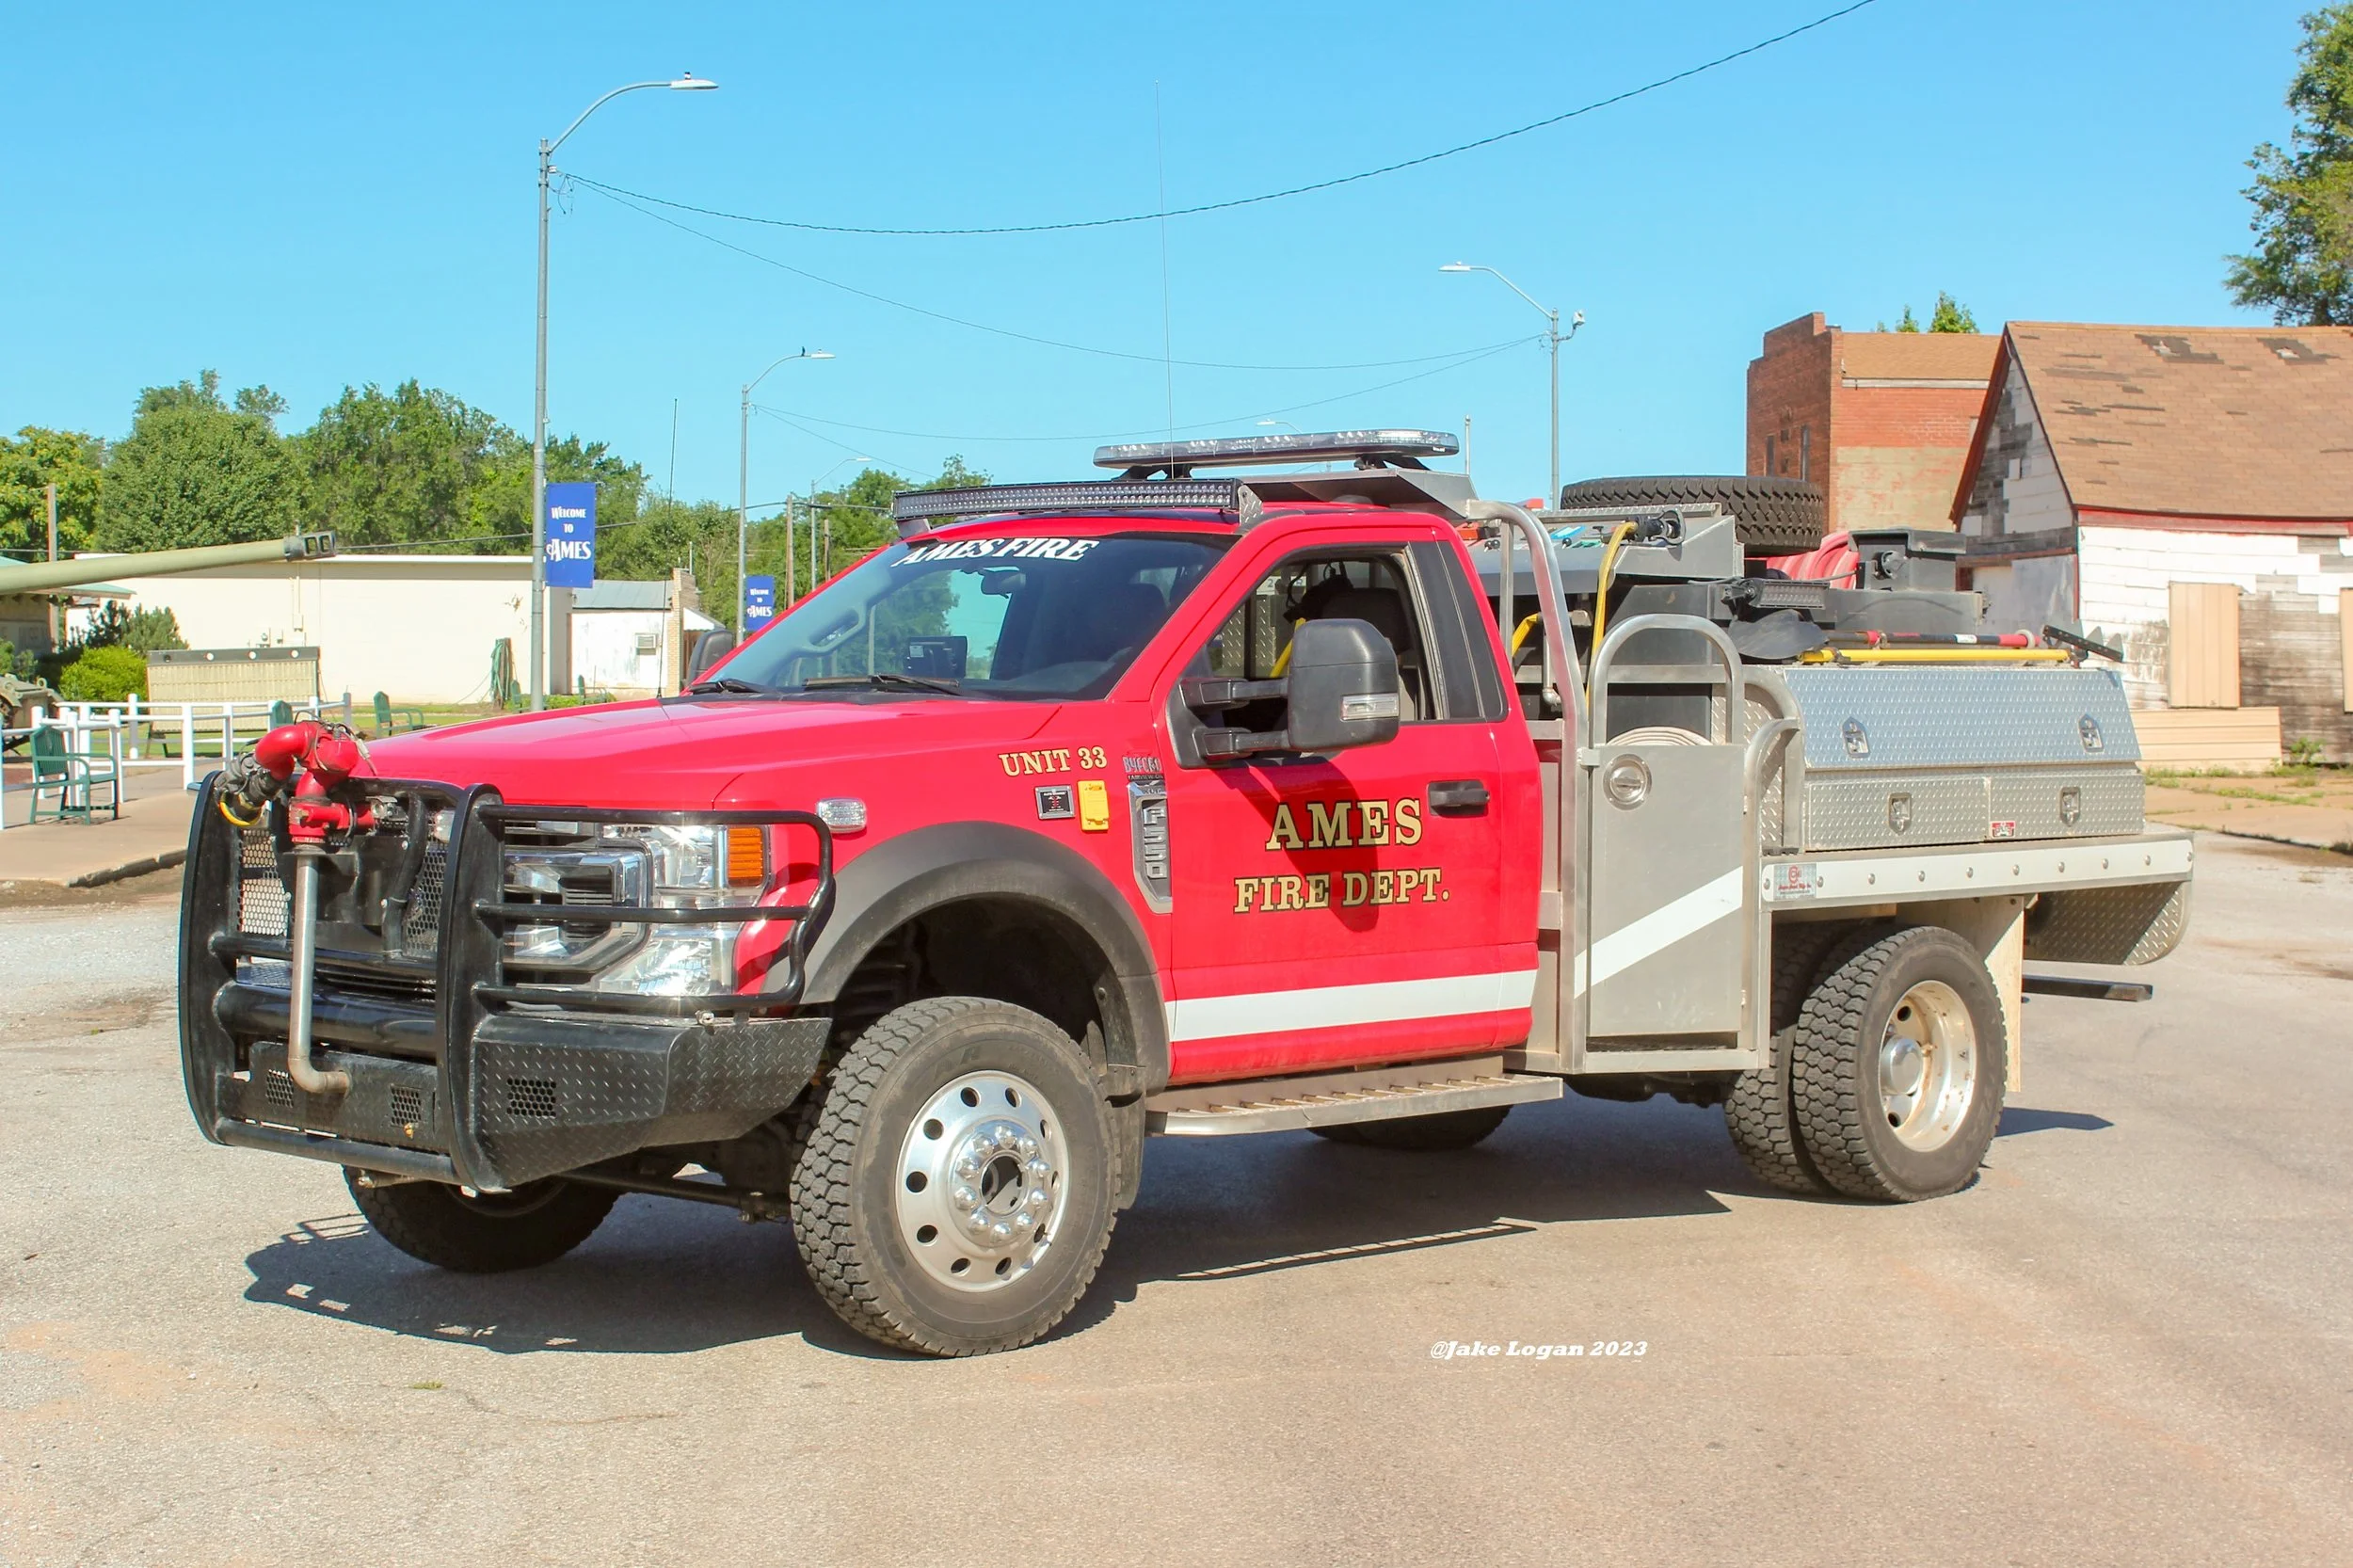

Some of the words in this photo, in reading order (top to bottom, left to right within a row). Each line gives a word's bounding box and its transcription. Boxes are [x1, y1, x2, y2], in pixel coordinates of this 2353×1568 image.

[563, 523, 574, 534] TO
[546, 538, 592, 562] AMES
[890, 538, 1006, 567] AMES
[991, 537, 1099, 561] FIRE
[746, 604, 773, 618] AMES
[998, 748, 1071, 776] UNIT
[1077, 745, 1108, 770] 33
[1265, 797, 1423, 851] AMES
[1233, 872, 1331, 915] FIRE
[1340, 867, 1451, 907] DEPT.
